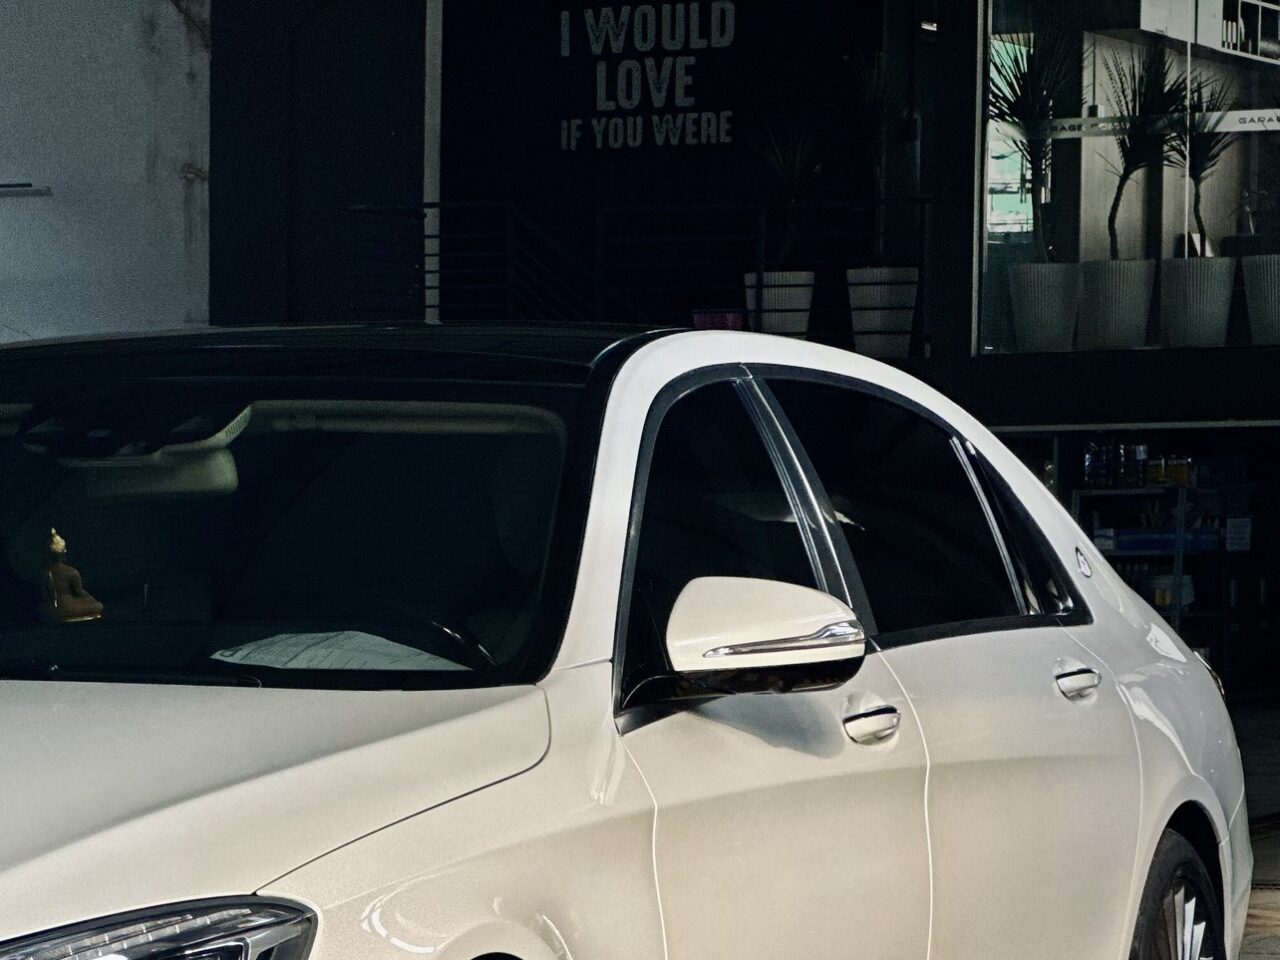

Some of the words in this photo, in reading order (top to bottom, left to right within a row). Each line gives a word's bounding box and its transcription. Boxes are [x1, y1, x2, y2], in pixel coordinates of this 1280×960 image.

[560, 9, 570, 57] I
[583, 0, 736, 56] WOULD
[596, 55, 697, 111] LOVE
[560, 117, 583, 151] IF
[591, 114, 644, 150] YOU
[651, 109, 734, 147] WERE
